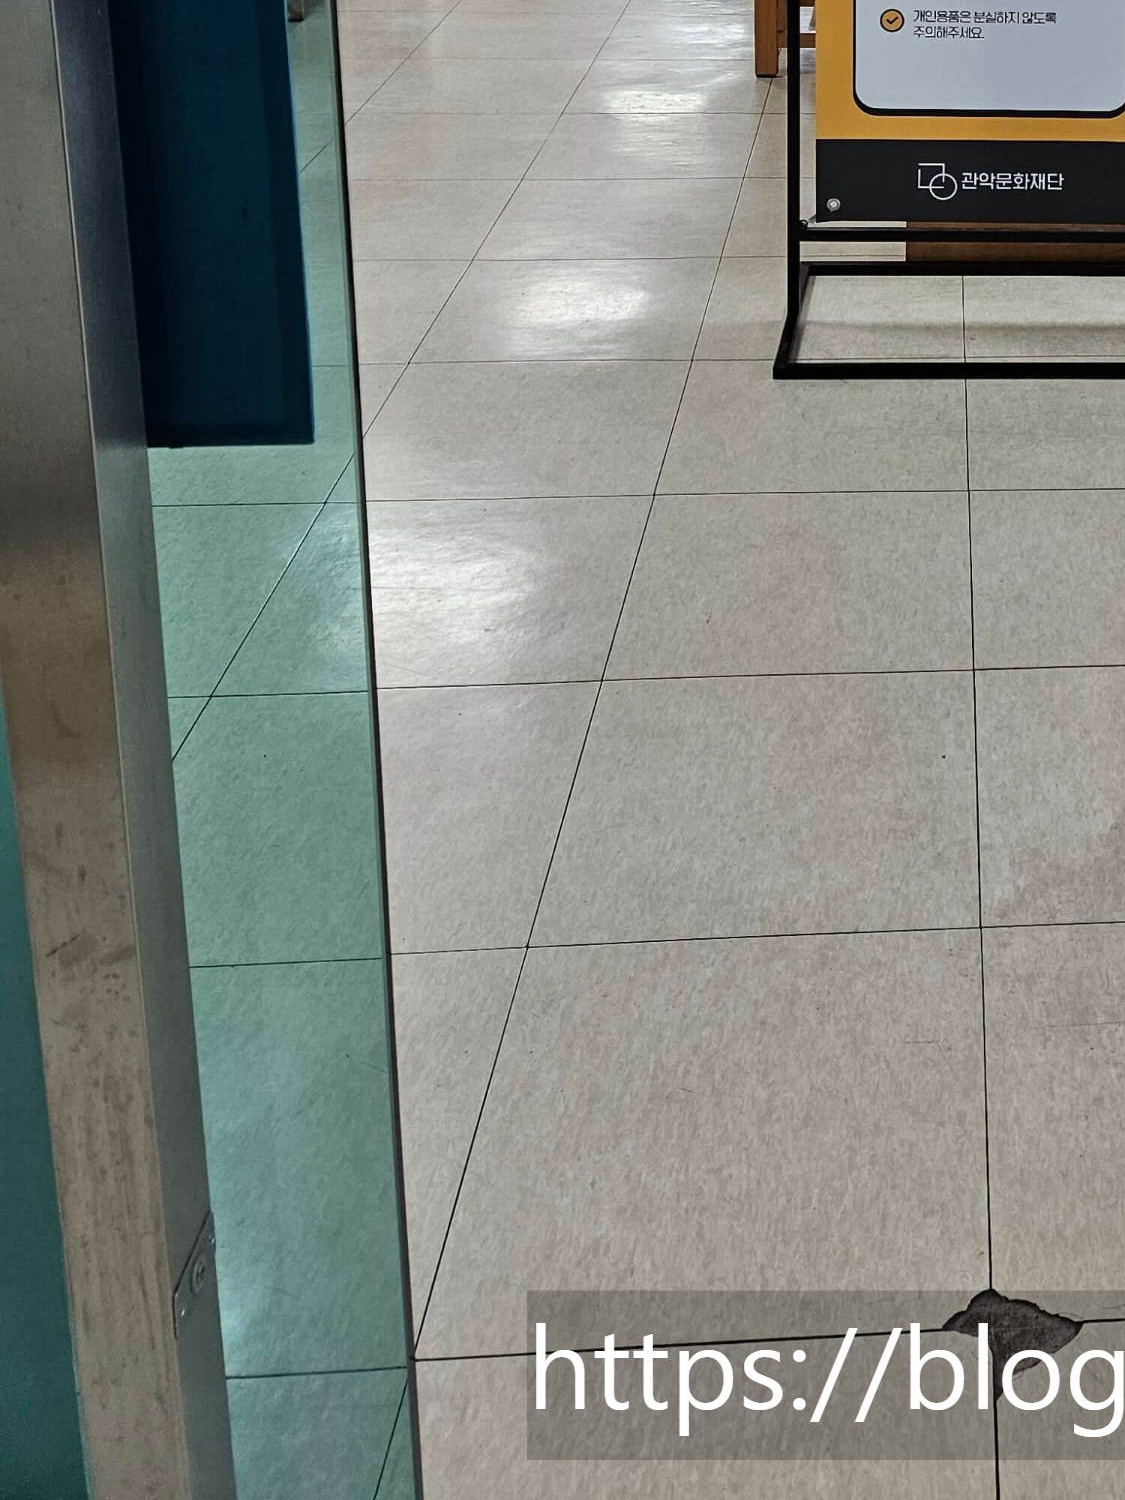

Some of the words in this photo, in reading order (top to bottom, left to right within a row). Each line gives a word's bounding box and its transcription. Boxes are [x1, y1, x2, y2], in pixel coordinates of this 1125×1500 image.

[913, 8, 971, 24] 개인용품은
[973, 9, 1019, 25] 분실하지
[1021, 11, 1056, 25] 않도록
[961, 169, 1064, 193] 관악문화재단
